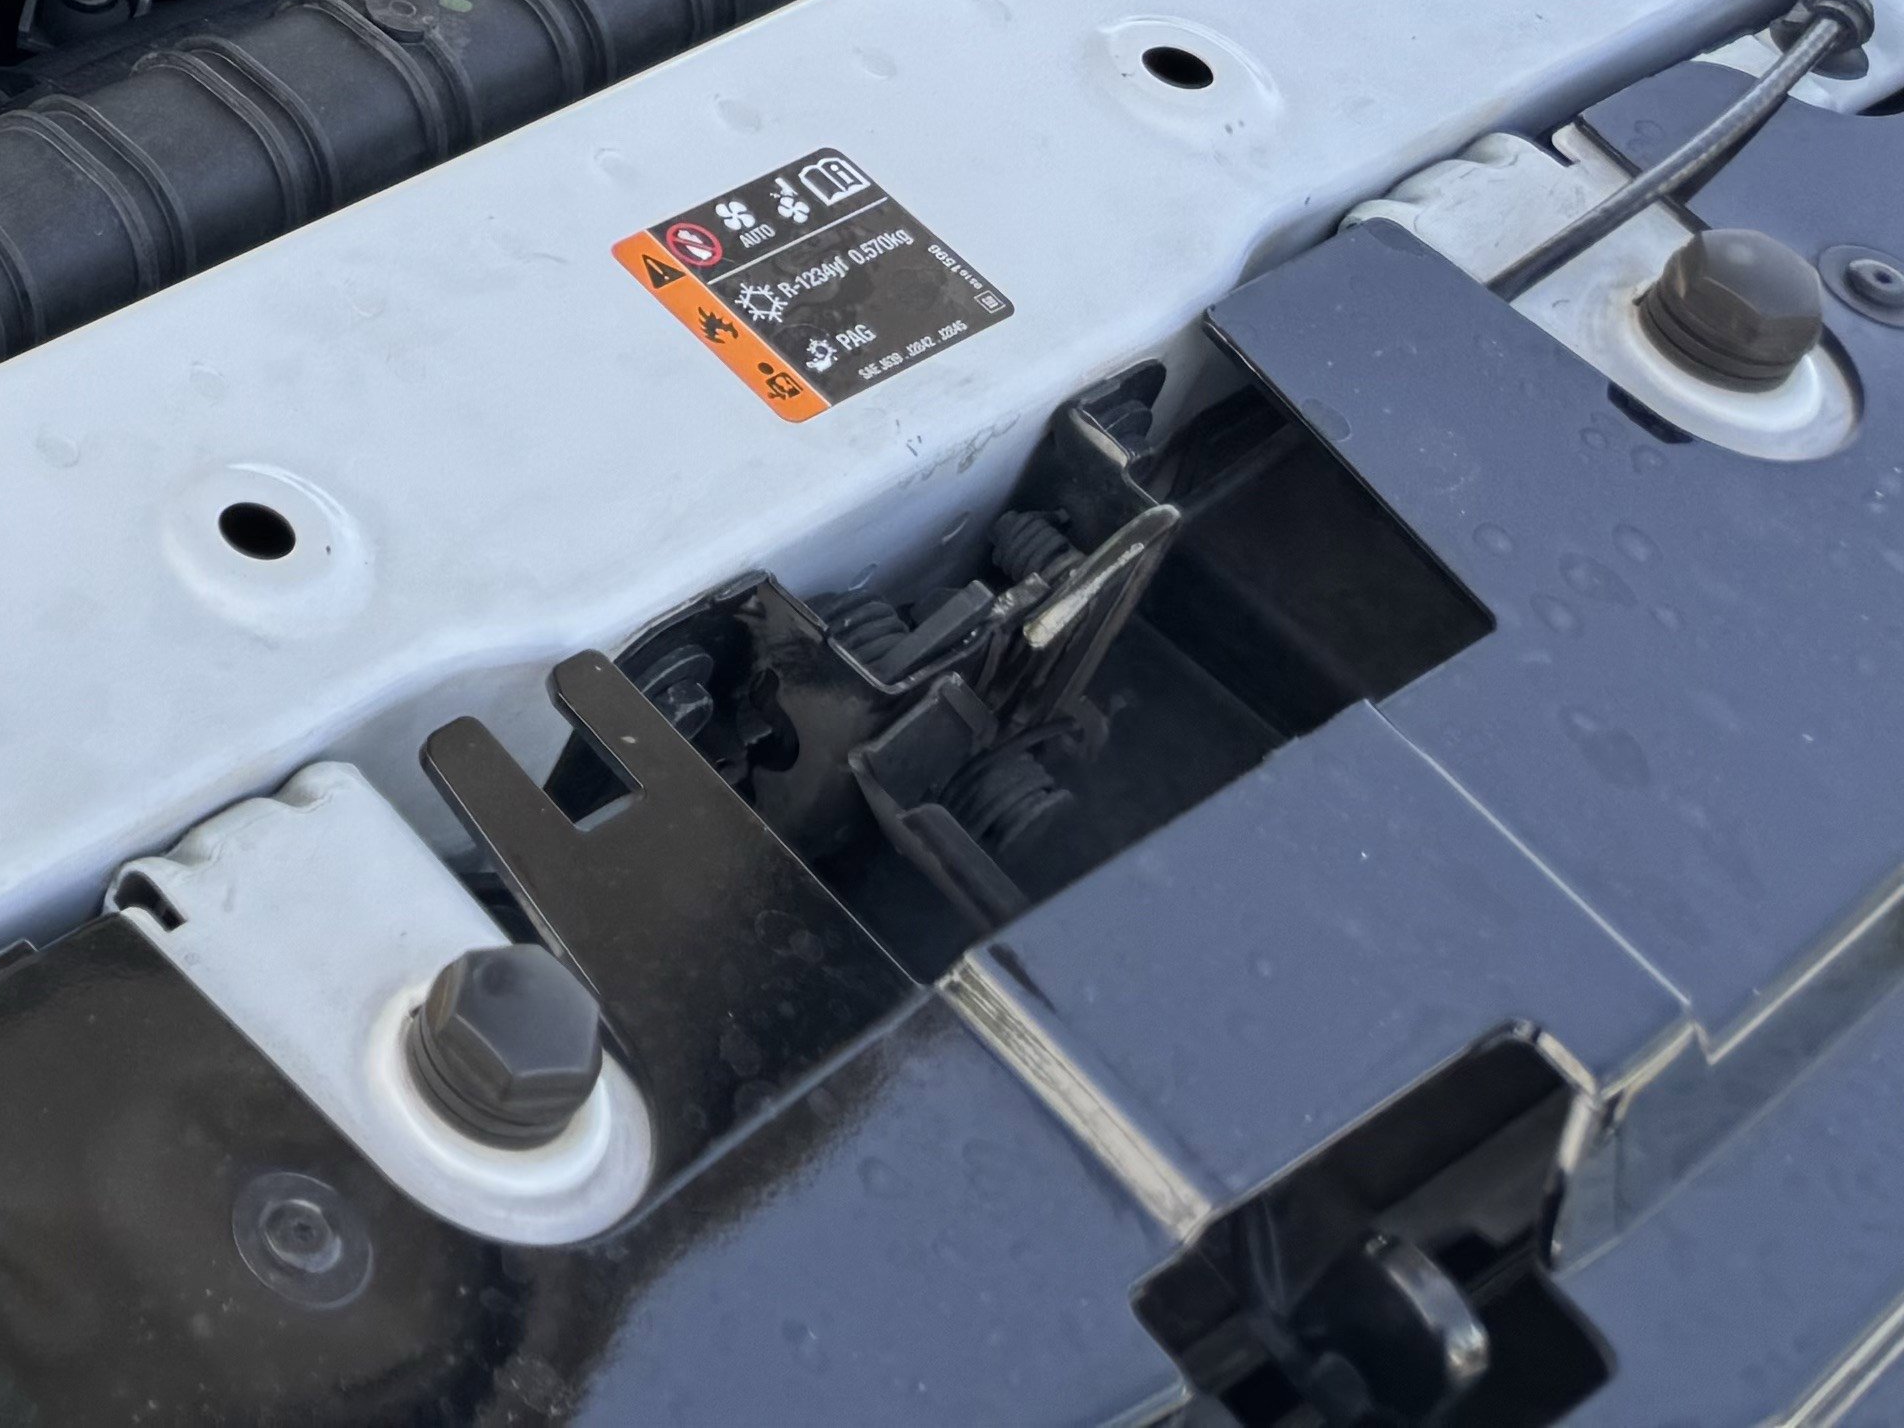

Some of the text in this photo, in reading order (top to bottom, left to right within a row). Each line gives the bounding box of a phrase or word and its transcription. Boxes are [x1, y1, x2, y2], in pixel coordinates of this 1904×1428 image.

[739, 224, 776, 248] AUTO
[777, 229, 914, 298] R-1234yf 0.570kg
[835, 324, 877, 351] PAG
[858, 363, 882, 380] SAE
